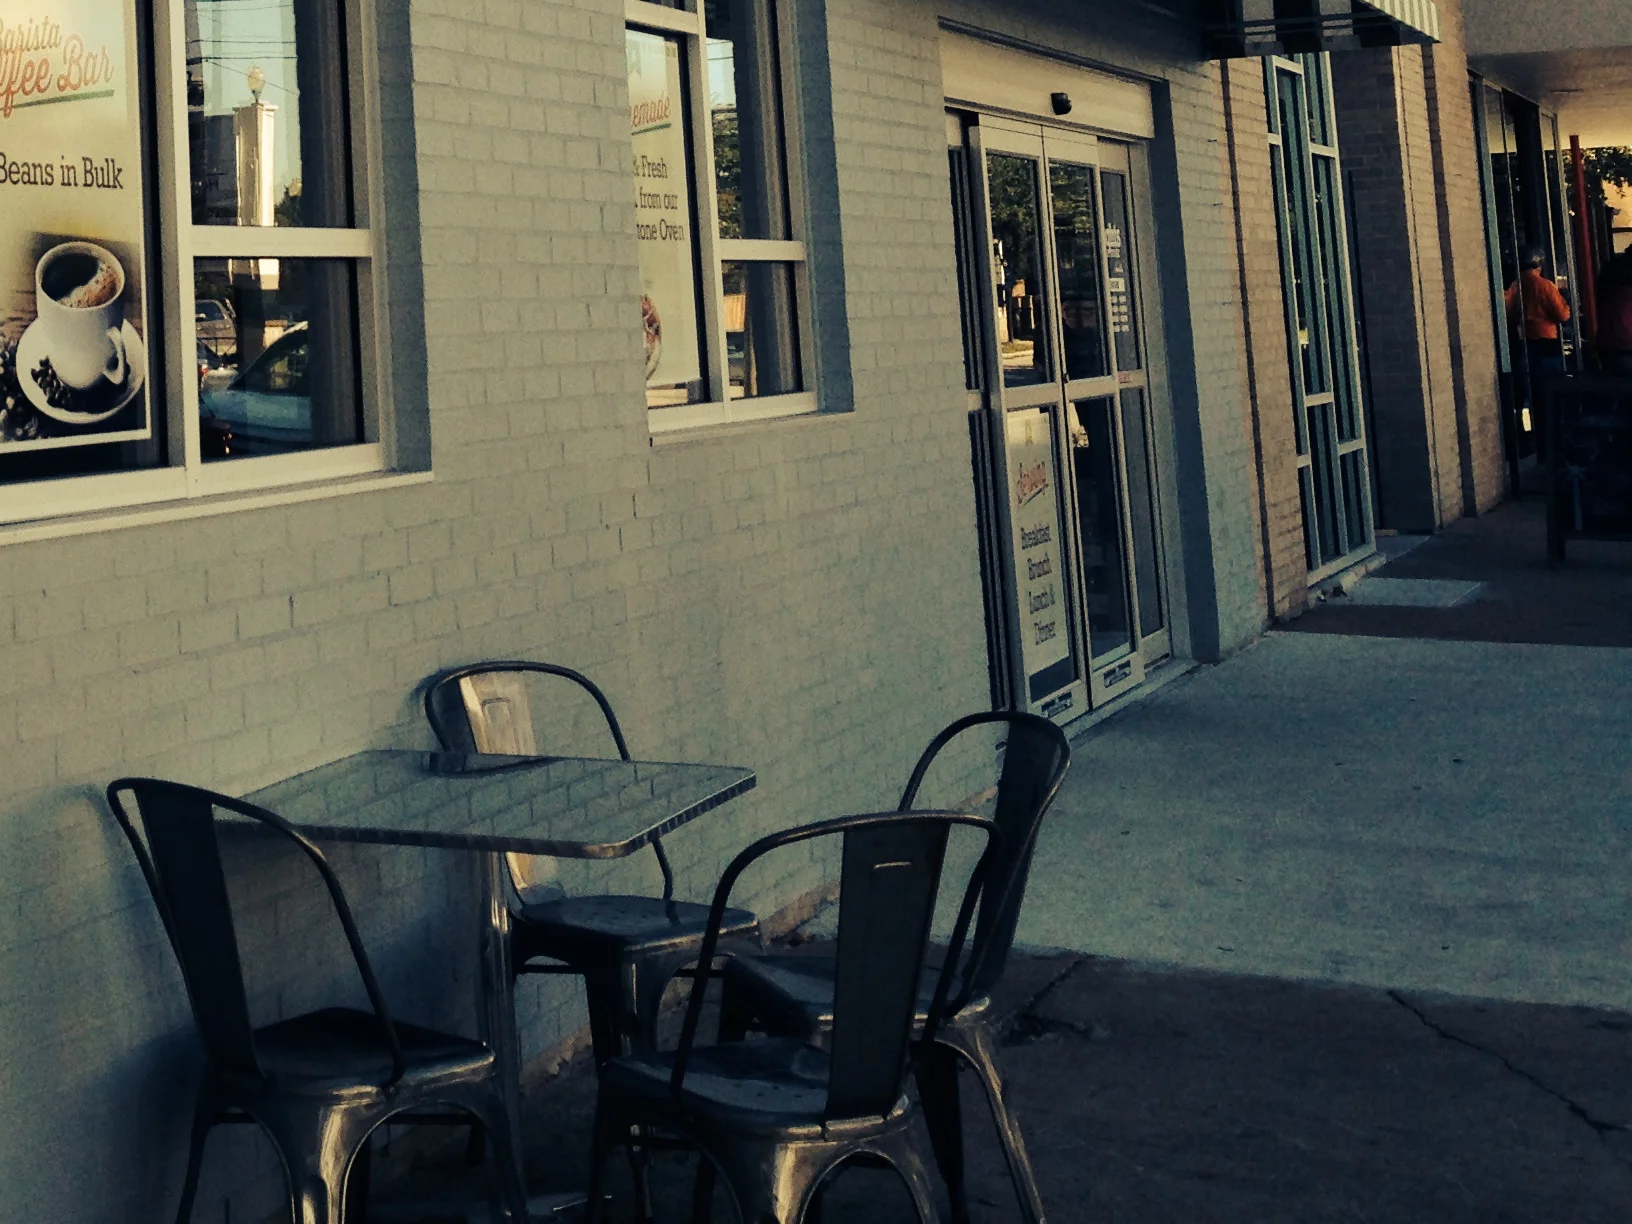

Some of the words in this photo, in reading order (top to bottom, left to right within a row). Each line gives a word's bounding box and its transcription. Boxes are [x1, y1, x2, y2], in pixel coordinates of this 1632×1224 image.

[57, 33, 115, 93] Bar
[631, 89, 670, 128] emade
[60, 155, 78, 187] in
[82, 156, 124, 189] Bulk
[641, 155, 668, 179] Fresh
[639, 186, 662, 210] from
[664, 194, 679, 210] our
[637, 220, 658, 241] tone
[659, 218, 685, 241] Oven
[1033, 621, 1056, 646] Dinner
